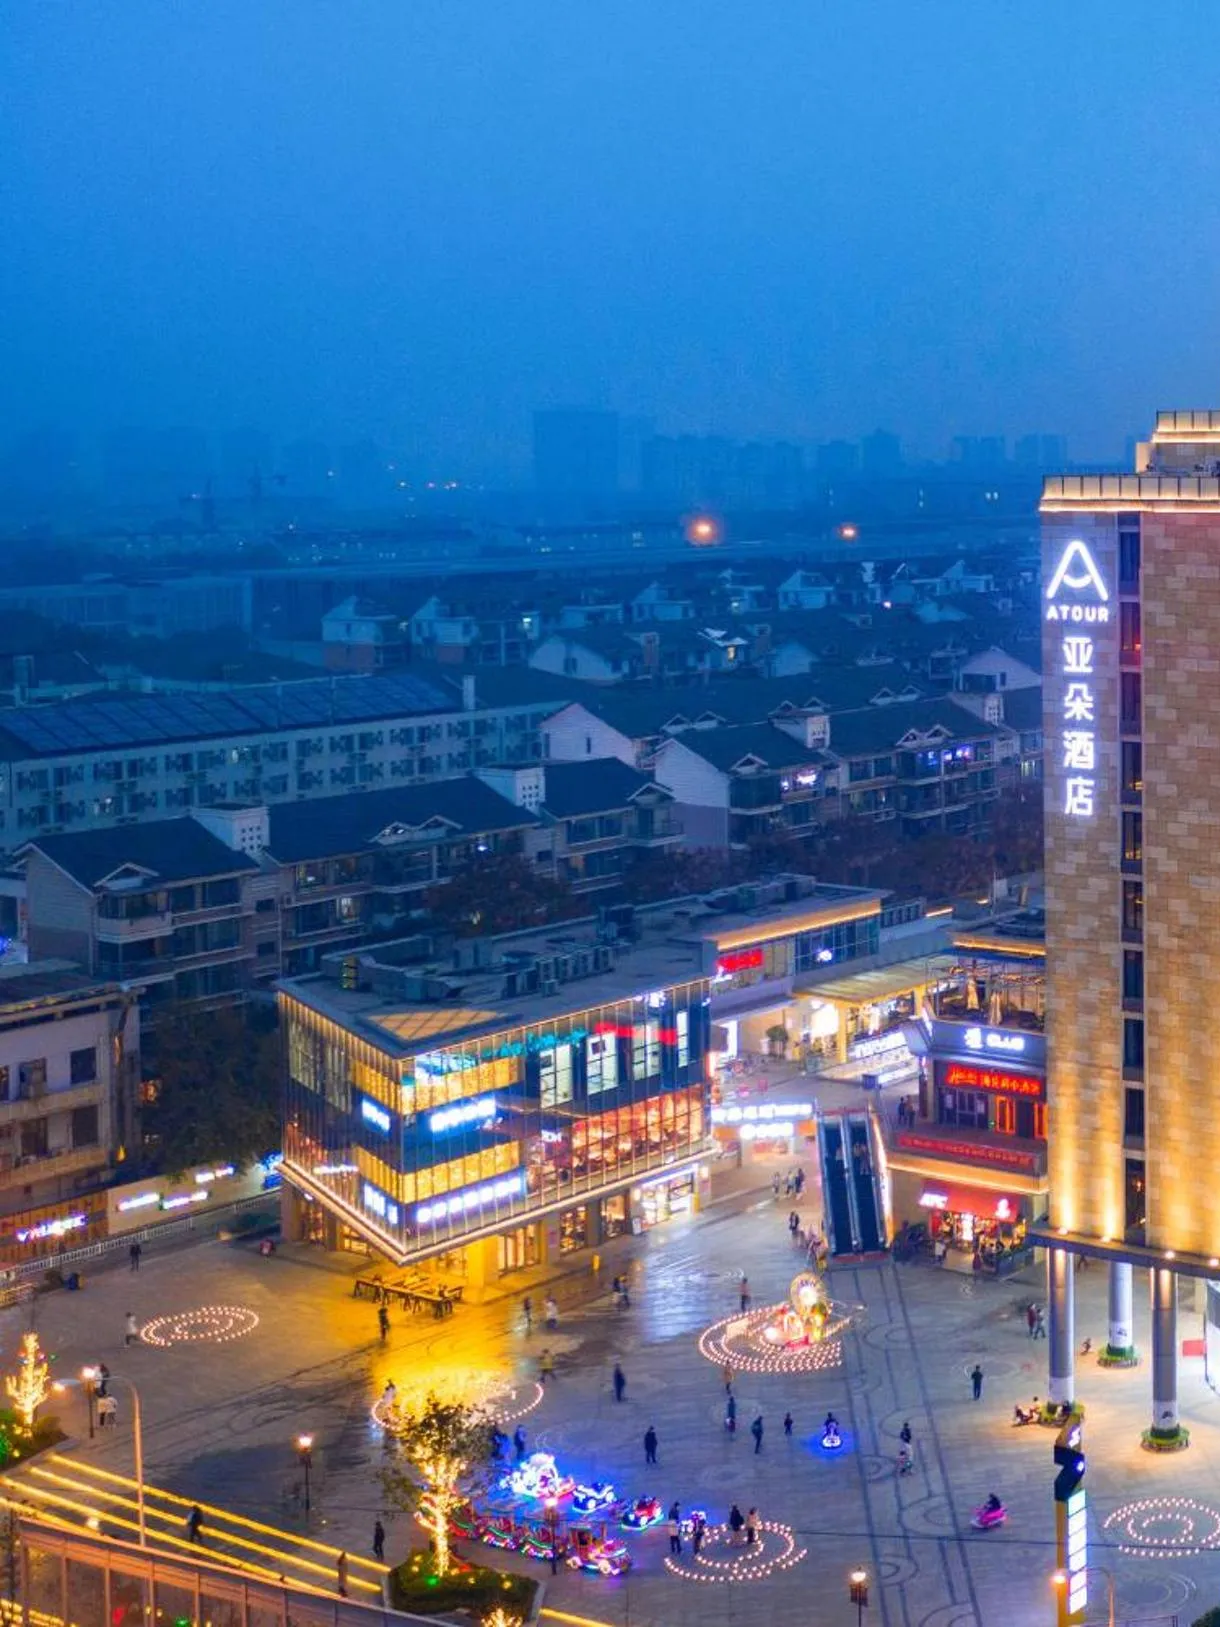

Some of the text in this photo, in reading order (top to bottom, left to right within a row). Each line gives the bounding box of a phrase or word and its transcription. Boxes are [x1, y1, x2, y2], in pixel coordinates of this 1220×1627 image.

[1046, 604, 1109, 622] ATOUR
[1063, 636, 1094, 816] 亚朵酒店
